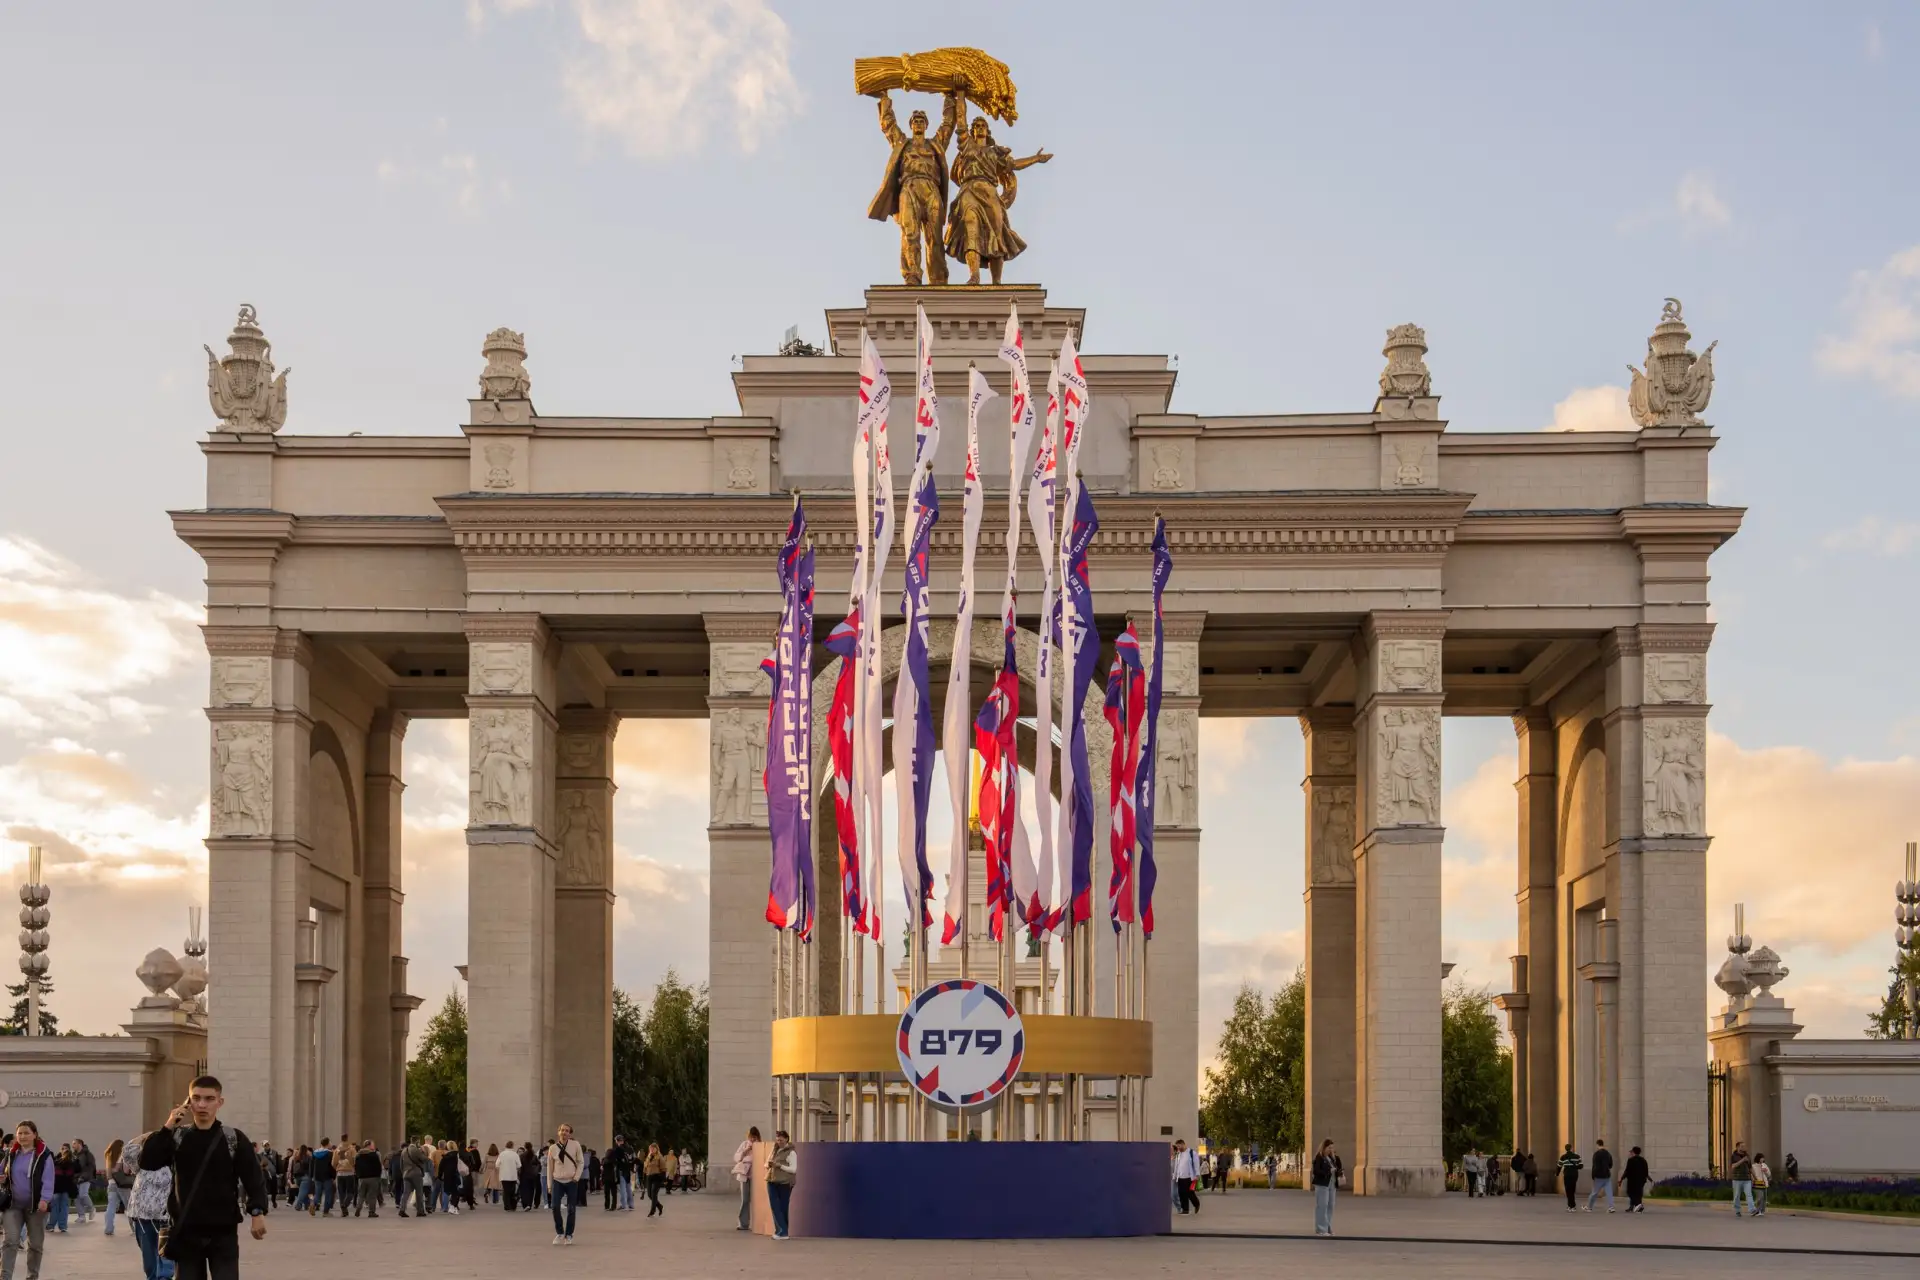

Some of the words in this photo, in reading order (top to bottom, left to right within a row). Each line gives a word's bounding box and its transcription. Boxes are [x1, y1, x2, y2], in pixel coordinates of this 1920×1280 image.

[920, 1029, 1002, 1055] 879
[12, 1089, 83, 1099] ИНФОЦЕНТР
[85, 1089, 115, 1099] ВДНХ
